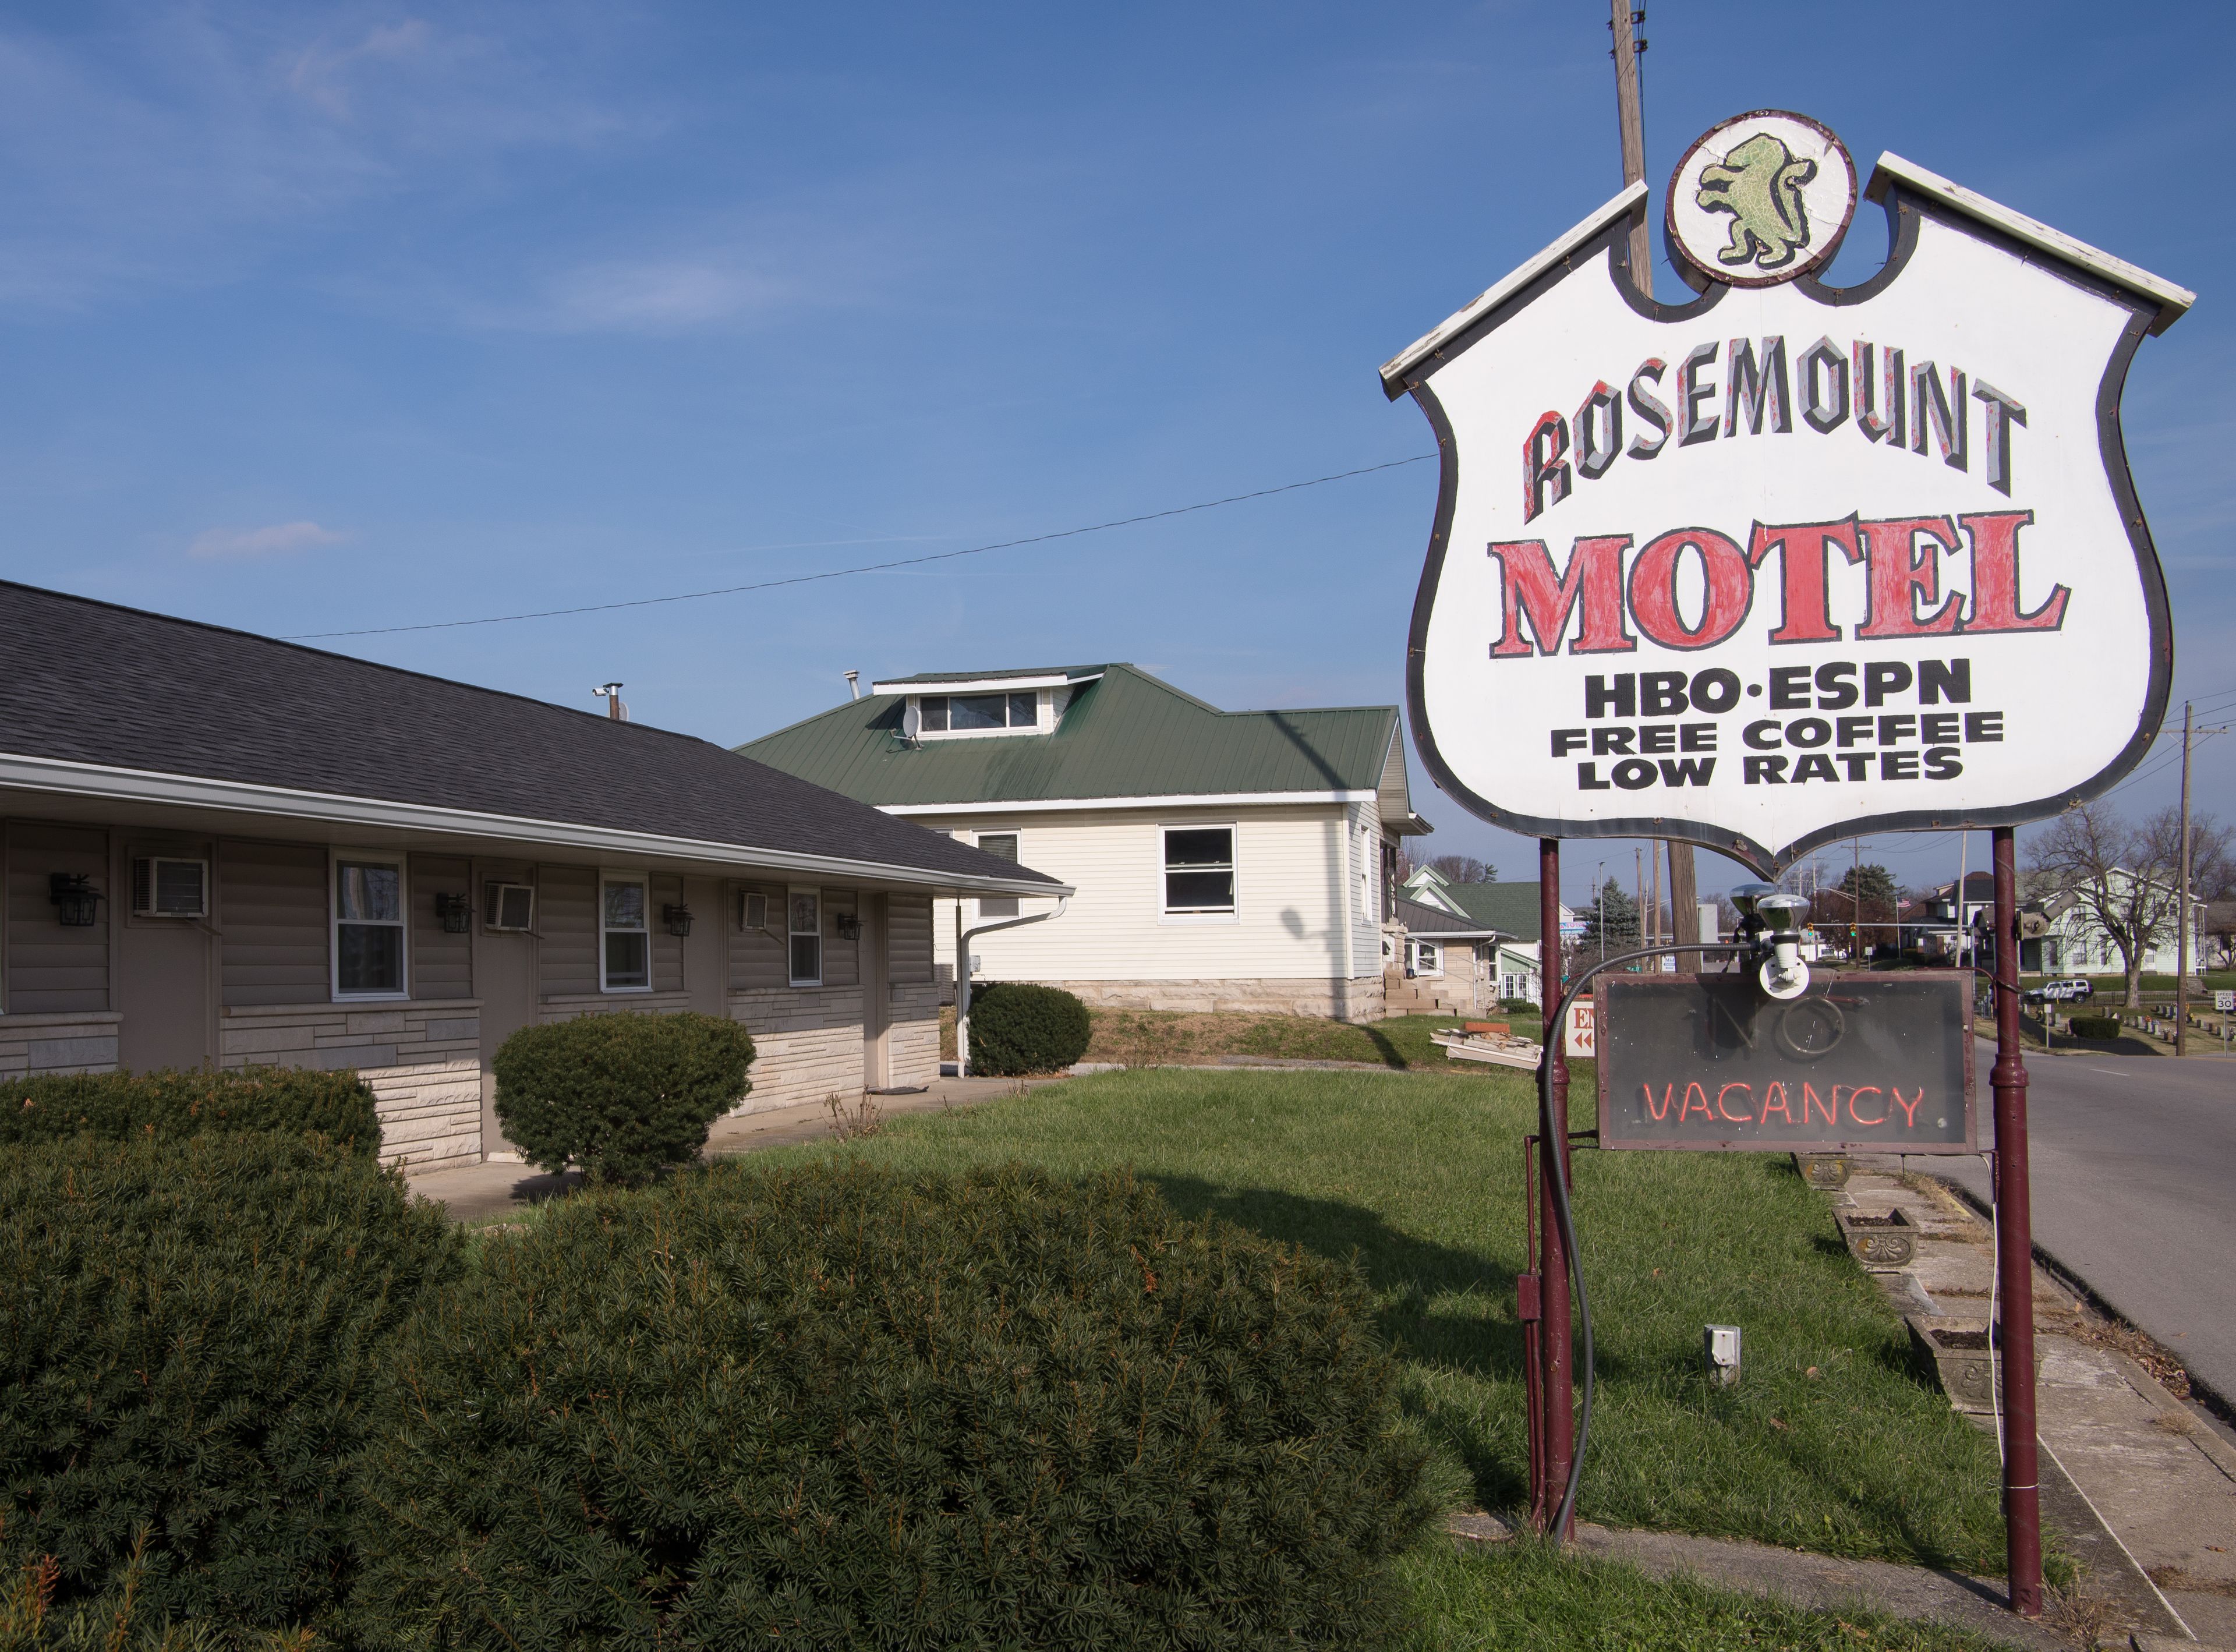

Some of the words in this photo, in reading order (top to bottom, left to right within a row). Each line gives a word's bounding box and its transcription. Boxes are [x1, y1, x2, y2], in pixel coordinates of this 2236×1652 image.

[1523, 335, 2027, 524] ROSEMOUNT
[1487, 510, 2071, 659] MOTEL
[1551, 722, 1717, 758] FREE
[1742, 711, 2004, 751] COFFEE
[1577, 757, 1717, 790] LOW
[1743, 747, 1963, 784] RATES
[1643, 1081, 1924, 1127] VACANCY
